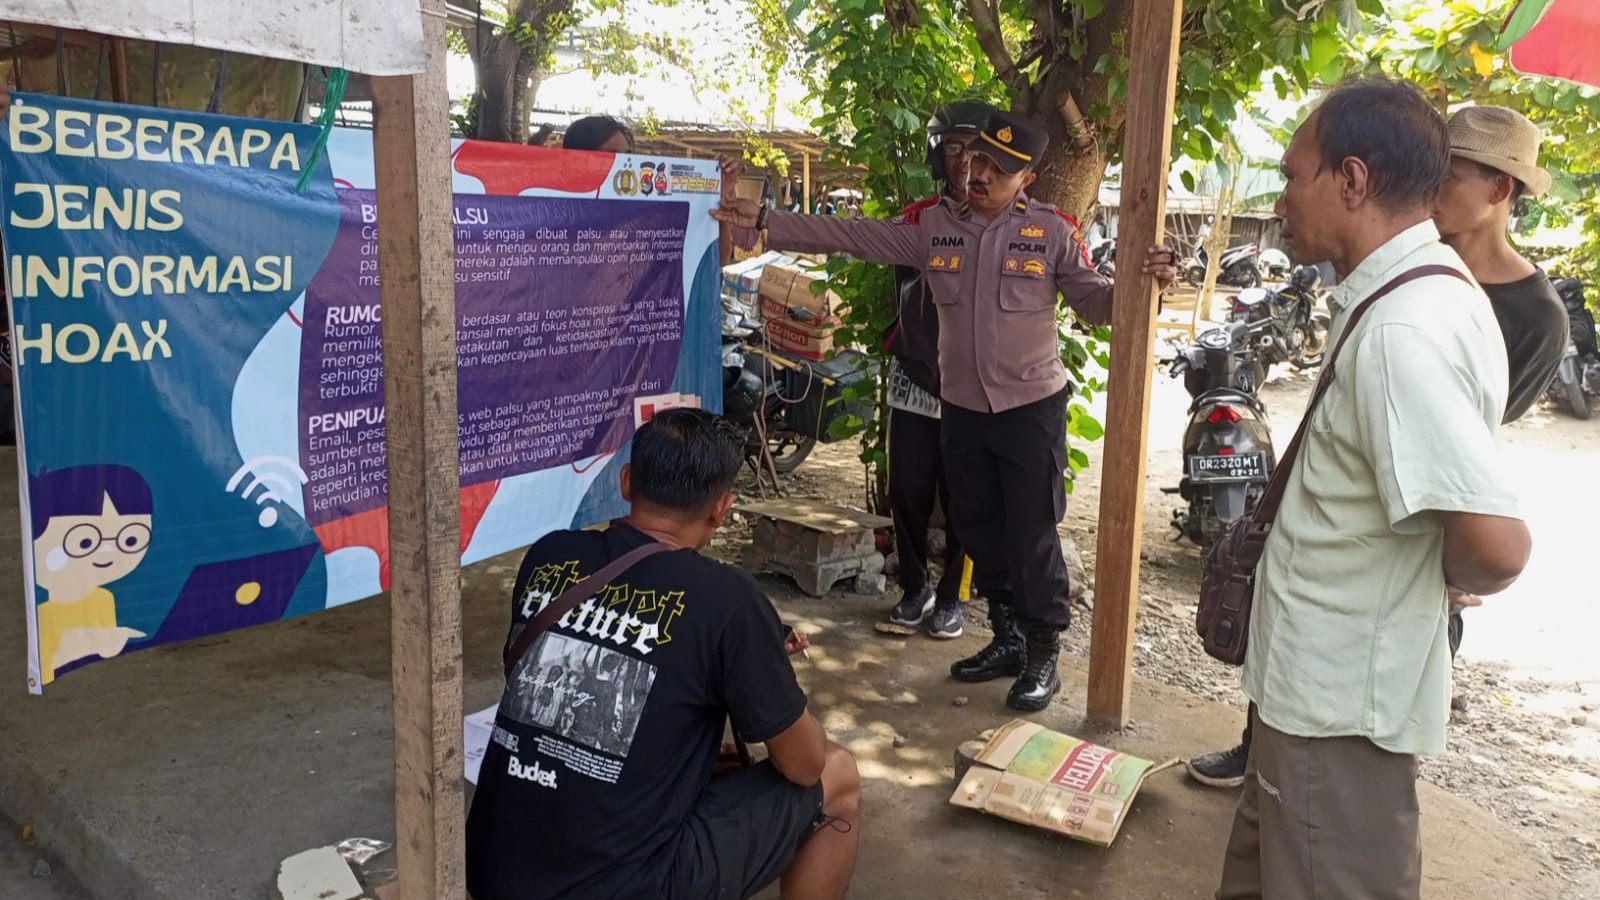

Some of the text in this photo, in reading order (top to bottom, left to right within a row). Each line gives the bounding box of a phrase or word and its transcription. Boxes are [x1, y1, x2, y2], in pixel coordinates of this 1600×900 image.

[9, 105, 300, 171] BEBERAPA
[10, 183, 183, 231] JENIS
[452, 207, 488, 224] LSU
[457, 226, 684, 243] ini sengaja dibuat palsu atau menyesatkan
[457, 239, 684, 257] untuk menipu orang dan menyebarkan informasi
[931, 236, 965, 248] DANA
[1008, 242, 1046, 254] POLRI
[12, 255, 292, 298] INFORMASI
[454, 269, 511, 283] su sensitif
[500, 253, 536, 267] adalah
[539, 253, 605, 267] memanipulasi
[607, 252, 629, 265] opini
[630, 251, 653, 264] publik
[656, 250, 682, 262] dengan
[323, 336, 382, 353] memilik
[456, 326, 493, 341] tansial
[496, 323, 539, 338] menjadi
[541, 320, 567, 333] fokus
[569, 318, 591, 330] hoax
[648, 309, 680, 320] mereka
[325, 324, 376, 338] Rumor
[462, 313, 511, 327] berdasar
[516, 311, 540, 323] atau
[545, 306, 568, 320] teori
[572, 303, 616, 317] konspirasi
[633, 300, 655, 312] yang
[659, 296, 680, 307] tidak
[326, 304, 382, 325] RUMO
[16, 319, 172, 366] HOAX
[322, 350, 383, 369] mengek
[523, 335, 543, 347] dan
[556, 327, 619, 343] ketidakpastian
[457, 355, 478, 368] kan
[481, 347, 547, 366] kepercayaan
[548, 343, 568, 356] luas
[570, 339, 609, 353] terhadap
[609, 335, 635, 347] klaim
[636, 333, 655, 347] yang
[656, 330, 681, 342] tidak
[320, 380, 378, 399] terbukti
[468, 407, 492, 421] web
[495, 402, 523, 419] palsu
[526, 398, 551, 414] yang
[554, 389, 609, 406] tampaknya
[612, 383, 638, 397] berasal
[641, 379, 661, 391] dari
[308, 405, 385, 435] PENIPUA
[309, 430, 352, 451] Email,
[457, 424, 476, 437] but
[479, 414, 520, 432] sebagai
[550, 402, 582, 419] tujuan
[585, 399, 618, 414] mereka
[309, 445, 363, 466] sumber
[458, 434, 484, 449] ividu
[487, 430, 511, 444] agar
[514, 417, 580, 438] memberikan
[582, 413, 603, 426] data
[310, 459, 356, 481] adalah
[311, 472, 357, 497] seperti
[460, 449, 485, 462] atau
[488, 442, 512, 456] data
[571, 427, 595, 441] yang
[313, 485, 379, 512] kemudian
[486, 452, 520, 469] untuk
[521, 446, 557, 463] tujuan
[560, 440, 583, 458] jahat
[520, 589, 660, 656] cture
